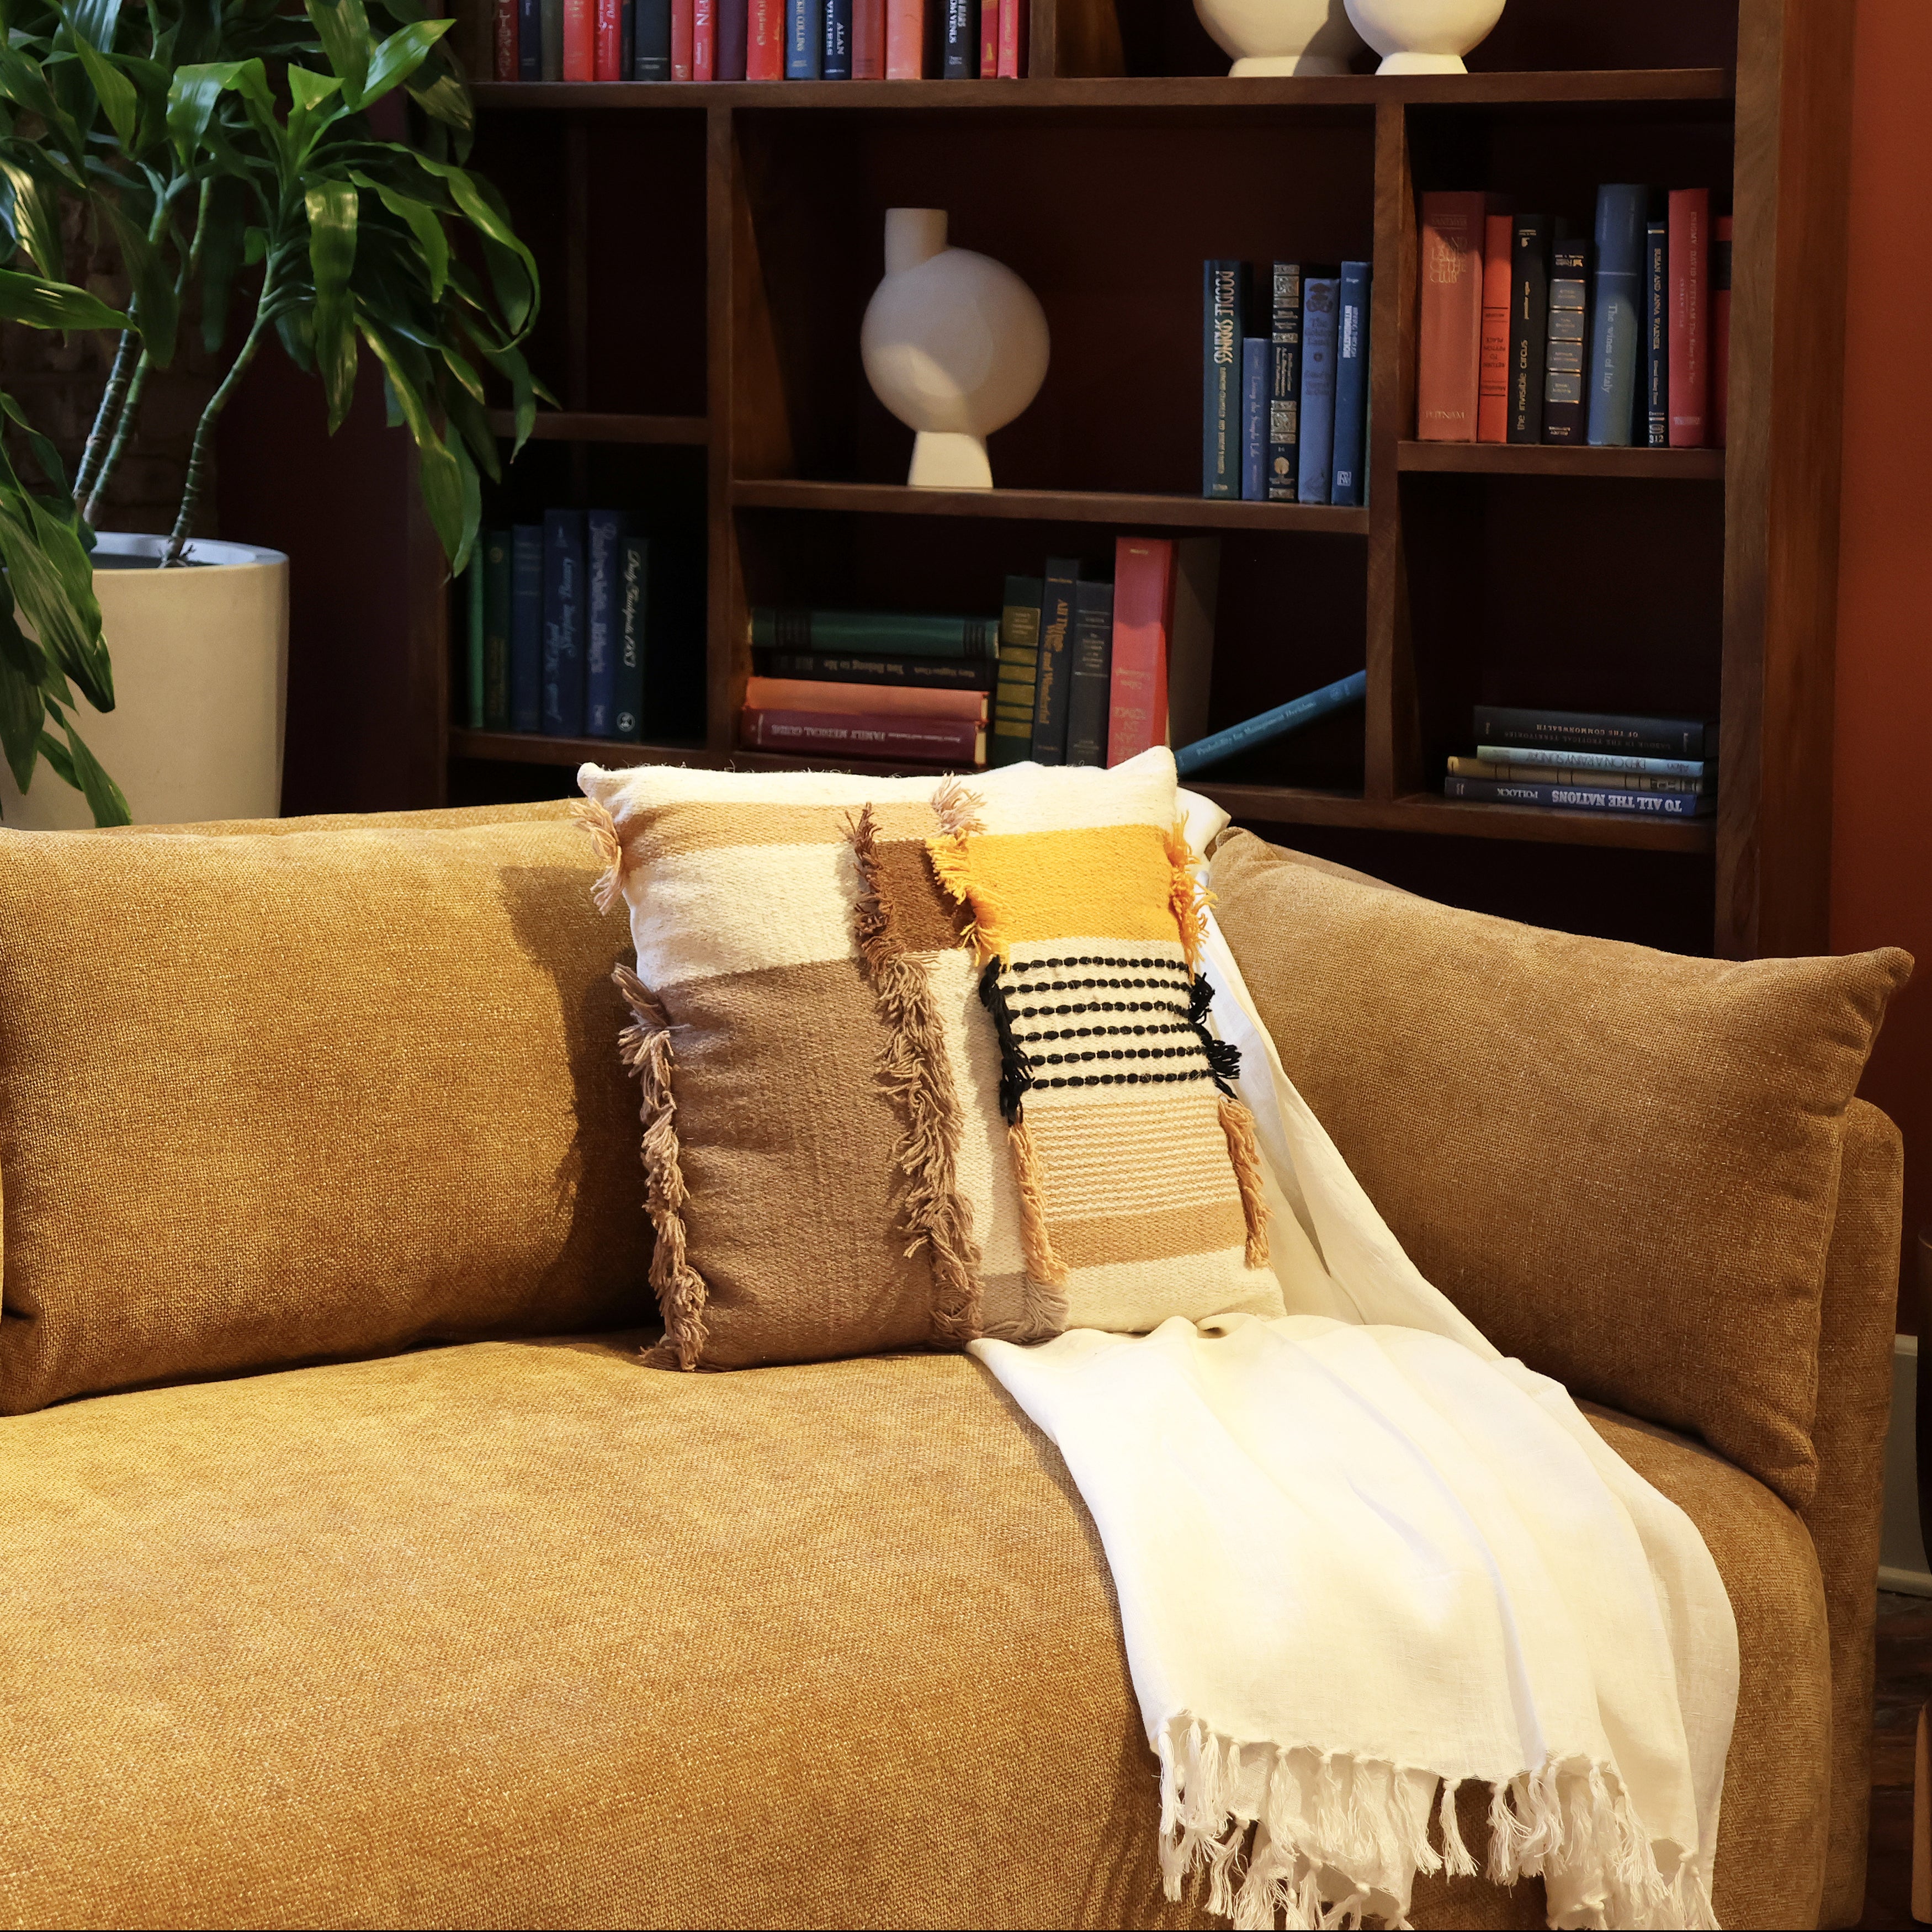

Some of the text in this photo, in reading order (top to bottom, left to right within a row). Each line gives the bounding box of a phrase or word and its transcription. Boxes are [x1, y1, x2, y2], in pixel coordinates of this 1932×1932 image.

[795, 16, 806, 52] COLLINS
[826, 0, 834, 56] VILLIERS
[836, 23, 845, 55] ALAN
[949, 14, 957, 44] VENUS
[1214, 270, 1235, 316] POODLE
[1607, 303, 1617, 322] The
[1213, 319, 1234, 364] SPRINGS
[1605, 358, 1614, 368] of
[1516, 339, 1528, 431] the invisible circus
[1601, 372, 1613, 393] Italy
[1056, 599, 1069, 616] All
[1536, 724, 1605, 736] COMMONWEALTH
[1496, 787, 1538, 799] POLLOCK
[1551, 789, 1682, 813] TO ALL THE NATIONS
